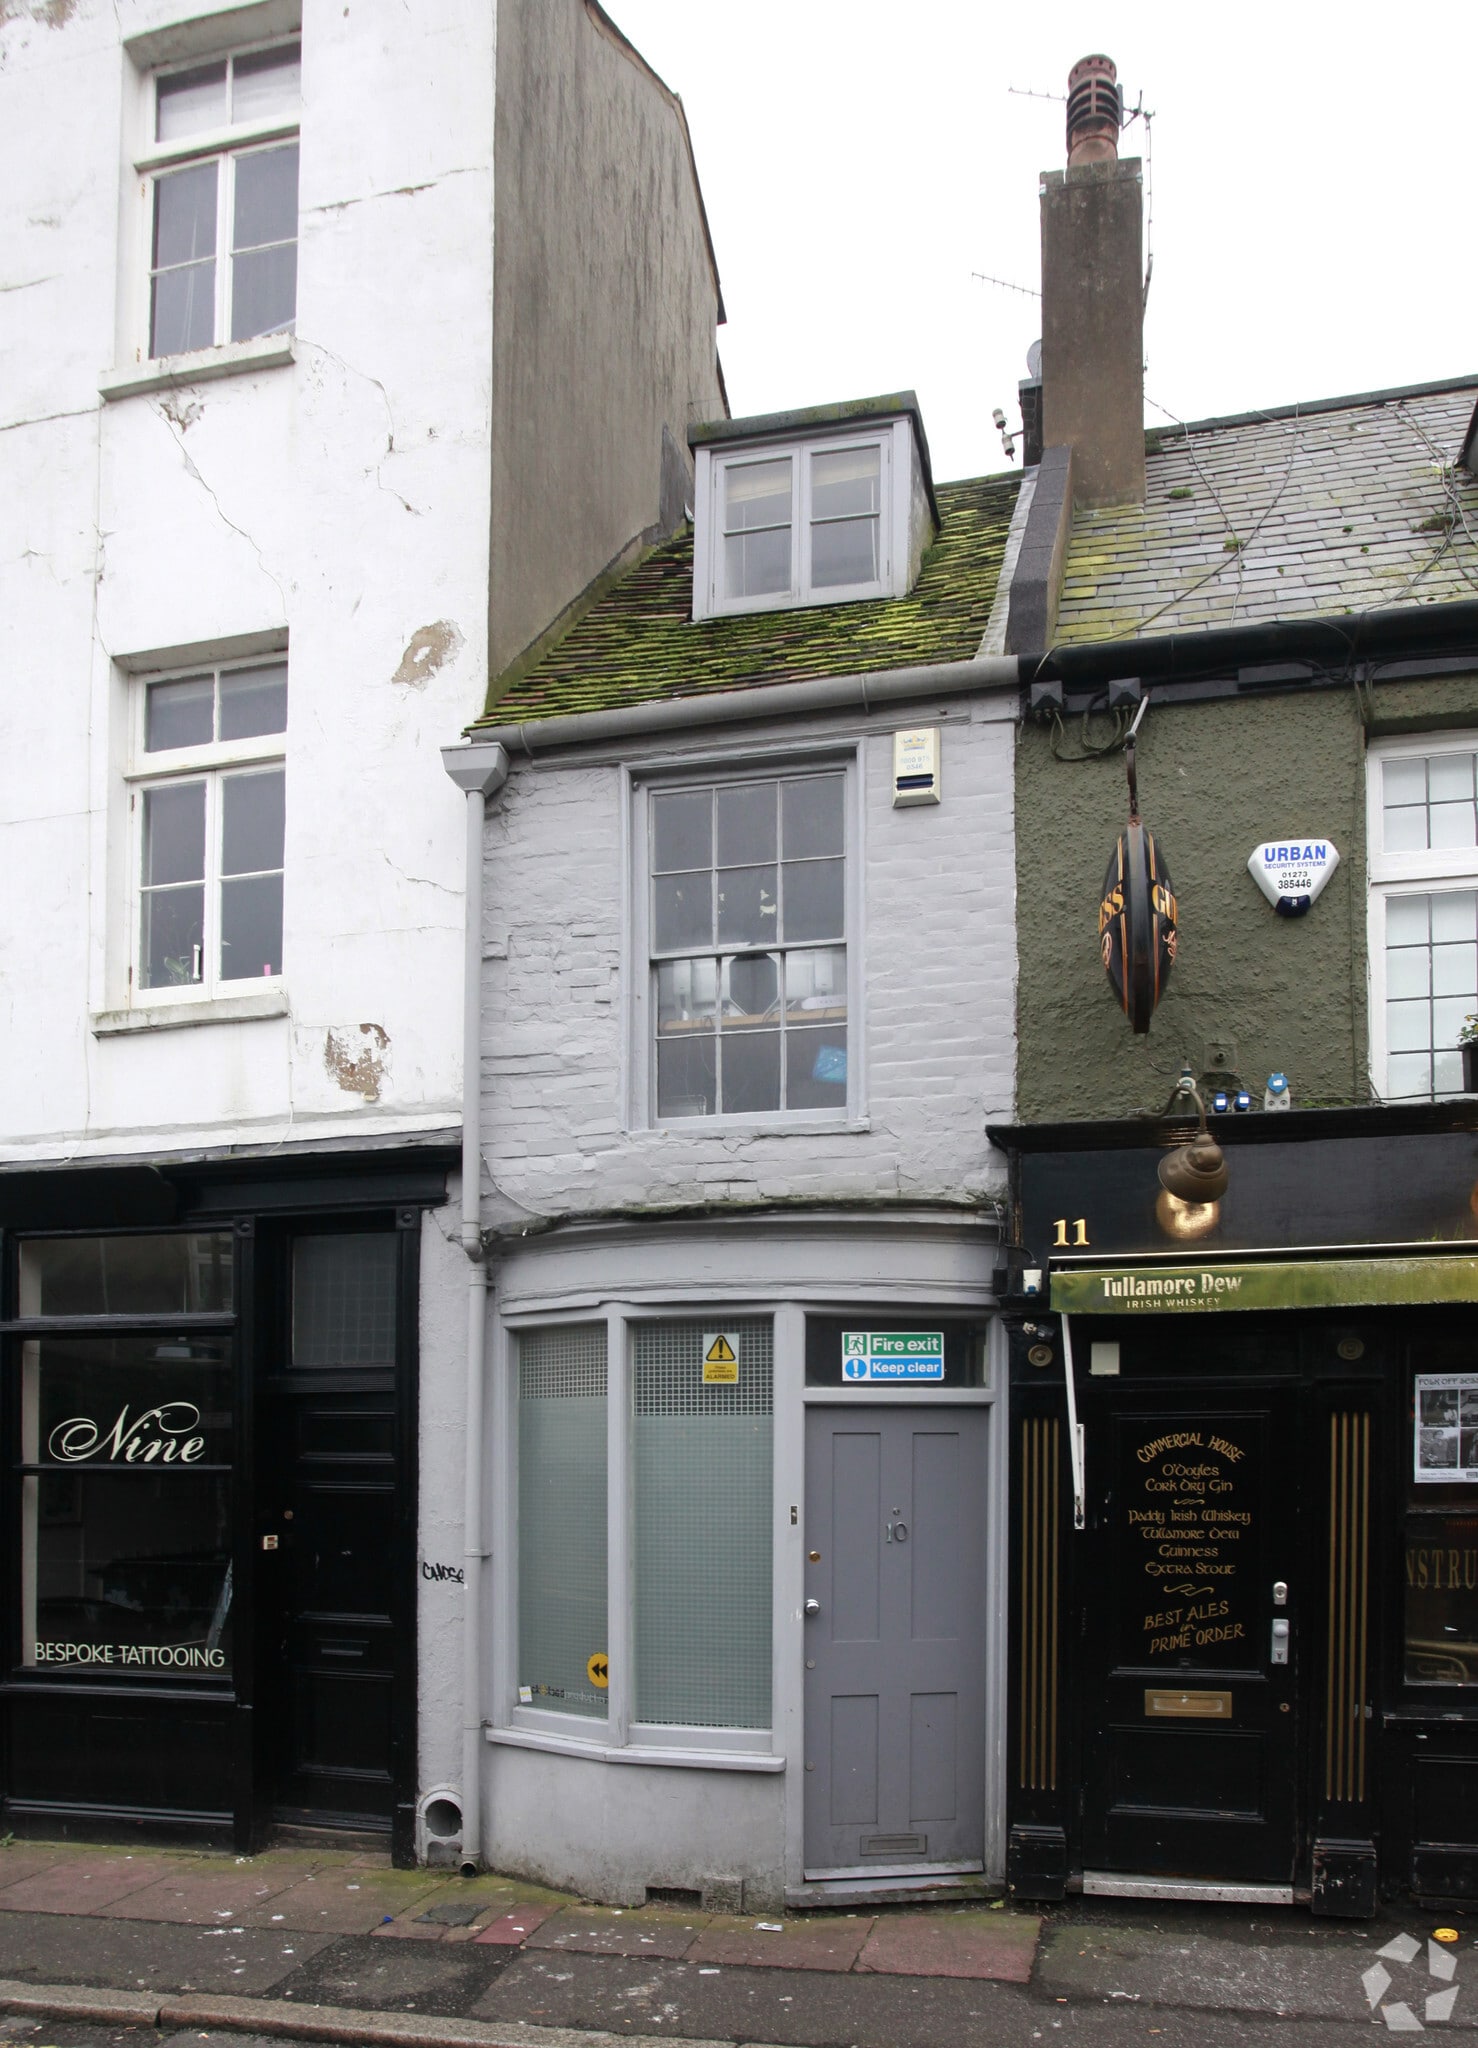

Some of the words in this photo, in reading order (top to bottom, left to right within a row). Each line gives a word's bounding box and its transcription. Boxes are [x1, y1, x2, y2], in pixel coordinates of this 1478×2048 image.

[1264, 845, 1326, 862] URBAN
[1278, 879, 1312, 889] 385446
[1052, 1218, 1090, 1247] 11
[1100, 1276, 1196, 1297] Tullamore
[1200, 1273, 1243, 1294] Dew
[1126, 1299, 1161, 1309] IRISH
[1166, 1297, 1221, 1307] WHISKEY
[872, 1337, 905, 1351] Fire
[907, 1337, 939, 1351] exit
[872, 1362, 905, 1375] Keep
[907, 1362, 939, 1373] clear
[48, 1401, 206, 1463] Nine
[1136, 1432, 1205, 1463] COMMERCIAL
[1207, 1435, 1246, 1463] HOUSE
[1145, 1478, 1178, 1492] Cork
[1180, 1478, 1206, 1495] Dry
[1208, 1479, 1233, 1493] Gin
[1128, 1509, 1166, 1525] Paddy
[1170, 1509, 1198, 1521] Irish
[1201, 1509, 1251, 1526] Whiskey
[886, 1521, 908, 1544] 10
[1140, 1526, 1205, 1539] Tullamore
[1209, 1526, 1240, 1539] Dew
[1158, 1544, 1219, 1558] Guinness
[1144, 1561, 1194, 1577] Extra
[1195, 1561, 1236, 1575] Stout
[1143, 1608, 1184, 1630] BEST
[1186, 1600, 1230, 1622] ALES
[1149, 1632, 1192, 1654] PRIME
[1195, 1623, 1246, 1646] ORDER
[34, 1642, 114, 1664] BESPOKE
[118, 1645, 225, 1668] TATTOOING
